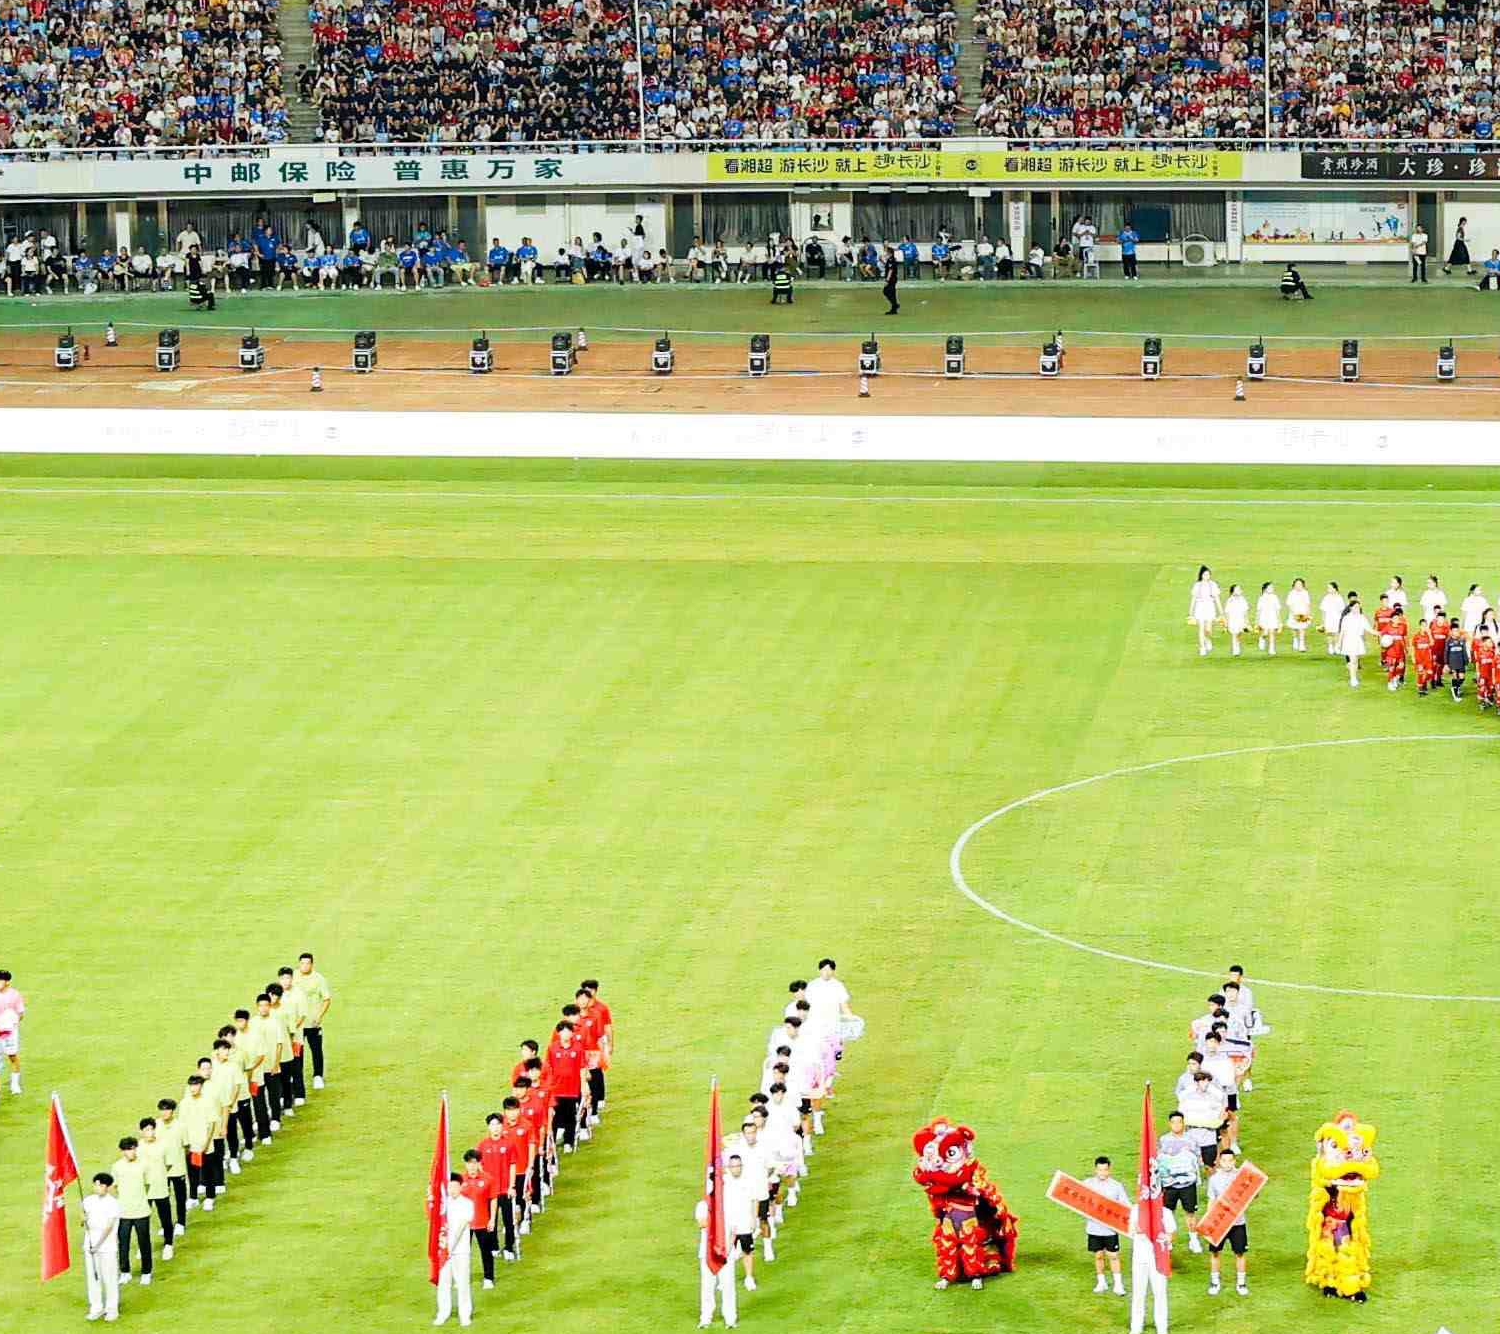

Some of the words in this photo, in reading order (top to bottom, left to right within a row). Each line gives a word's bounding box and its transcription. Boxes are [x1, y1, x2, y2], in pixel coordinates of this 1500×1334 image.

[183, 160, 355, 183] 中邮保险
[393, 158, 563, 180] 普惠万家
[724, 158, 772, 173] 看湘超
[780, 158, 828, 173] 游长沙
[836, 158, 867, 172] 就上
[1004, 157, 1052, 172] 看湘超
[1060, 157, 1107, 172] 游长沙
[1114, 158, 1145, 172] 就上
